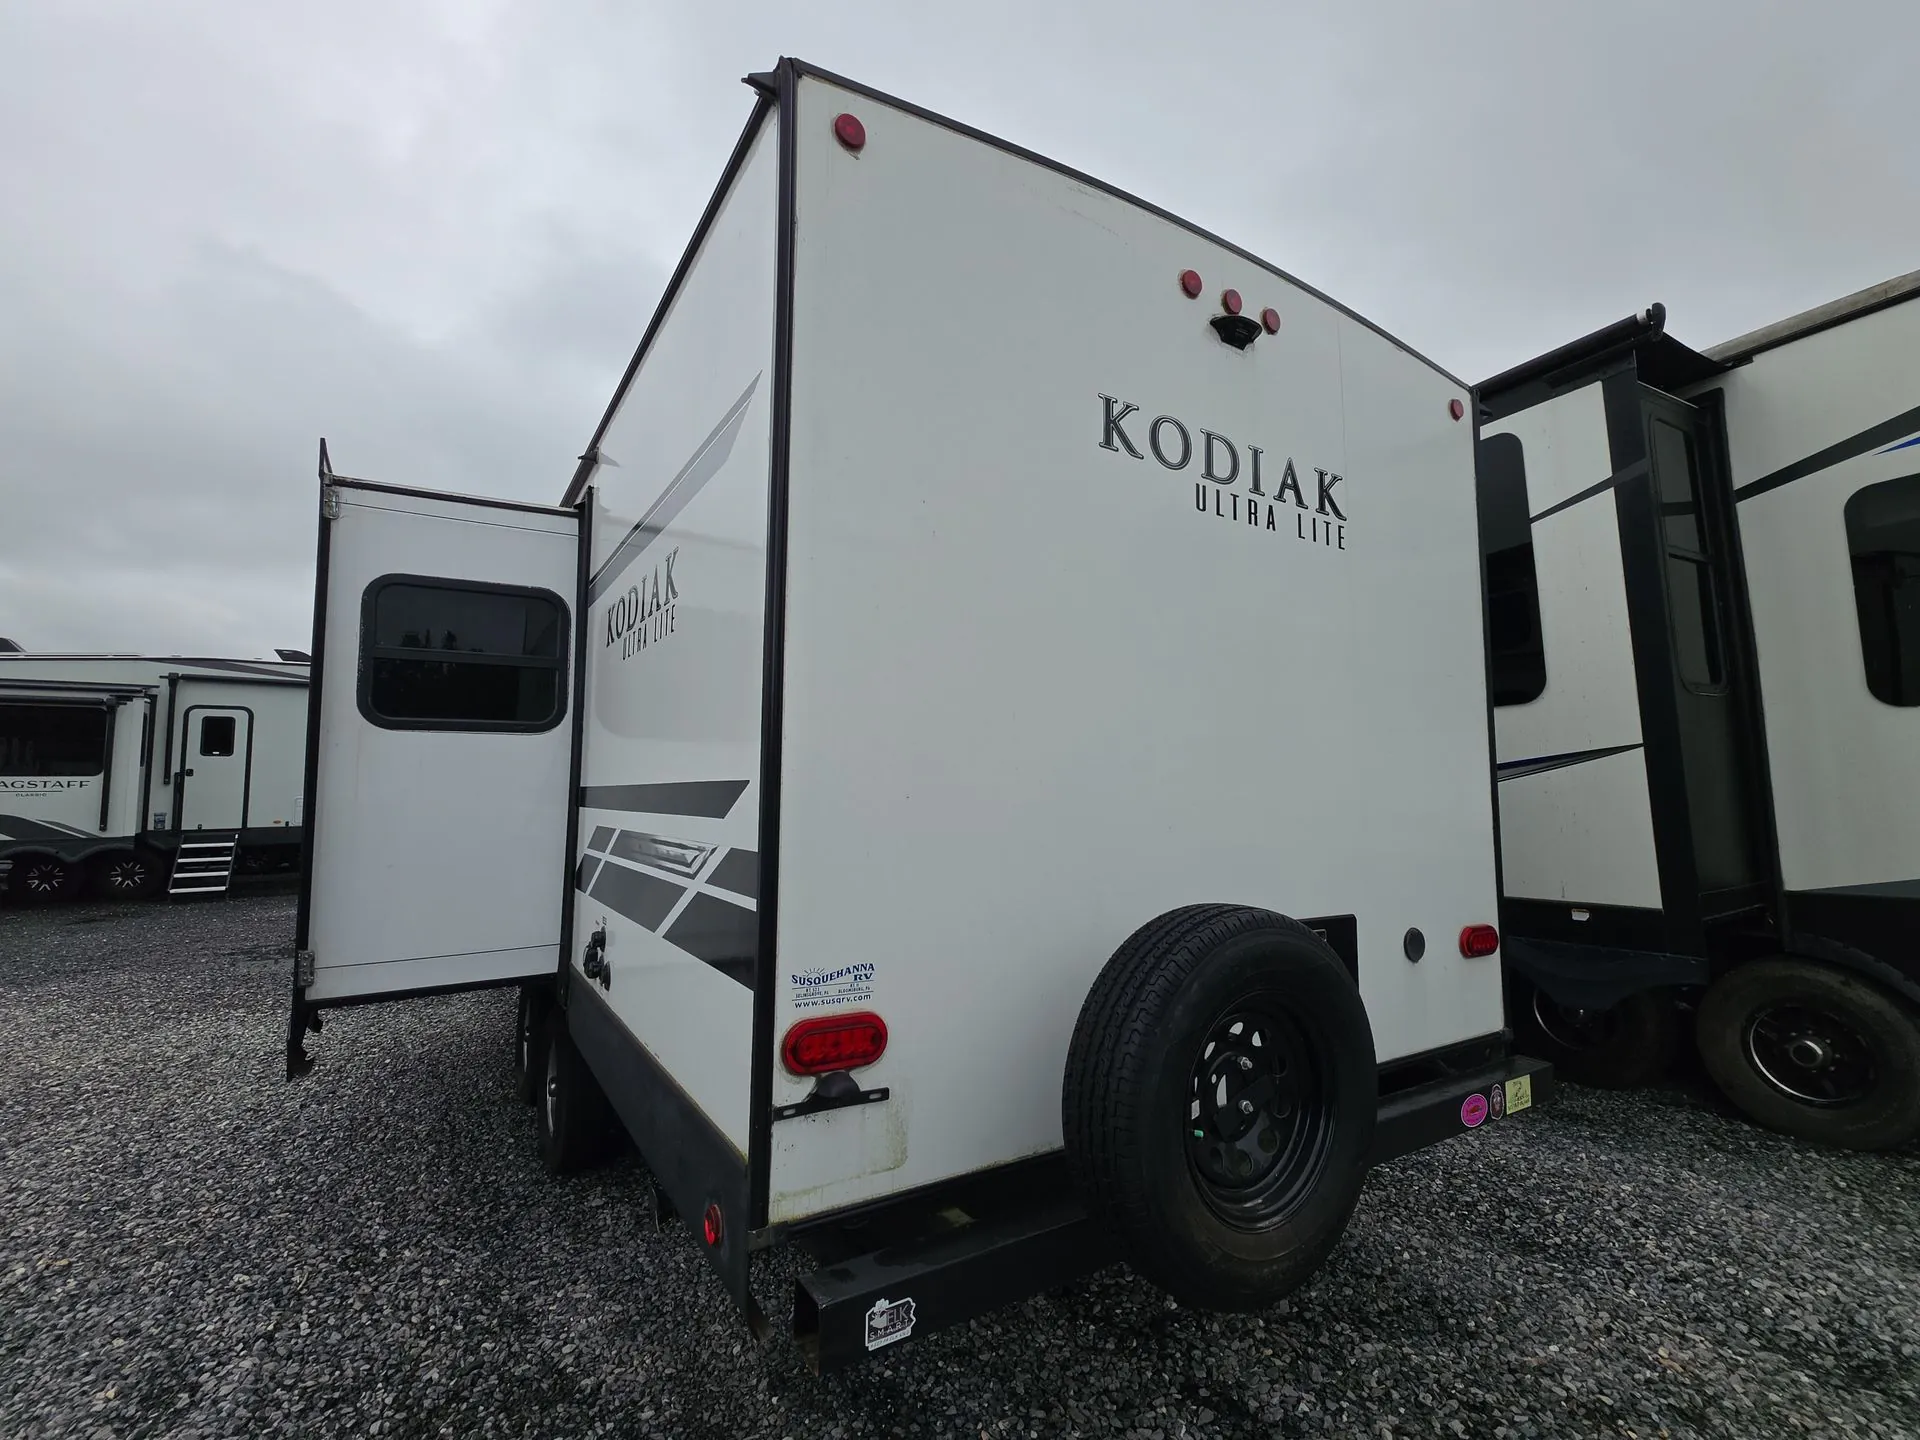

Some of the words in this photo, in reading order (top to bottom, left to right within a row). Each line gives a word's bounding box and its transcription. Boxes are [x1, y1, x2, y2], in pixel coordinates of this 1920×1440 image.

[1098, 393, 1347, 521] KODIAK
[1195, 483, 1276, 531] ULTRA
[1297, 513, 1346, 550] LITE
[606, 546, 680, 648] KODIAK
[622, 623, 647, 661] ULTRA
[654, 604, 676, 643] LITE
[791, 963, 875, 986] SUSQUEHANNA
[853, 972, 873, 981] RV
[794, 994, 871, 1008] www.susqrv.com
[887, 1304, 909, 1325] ELK
[869, 1319, 909, 1341] SMART
